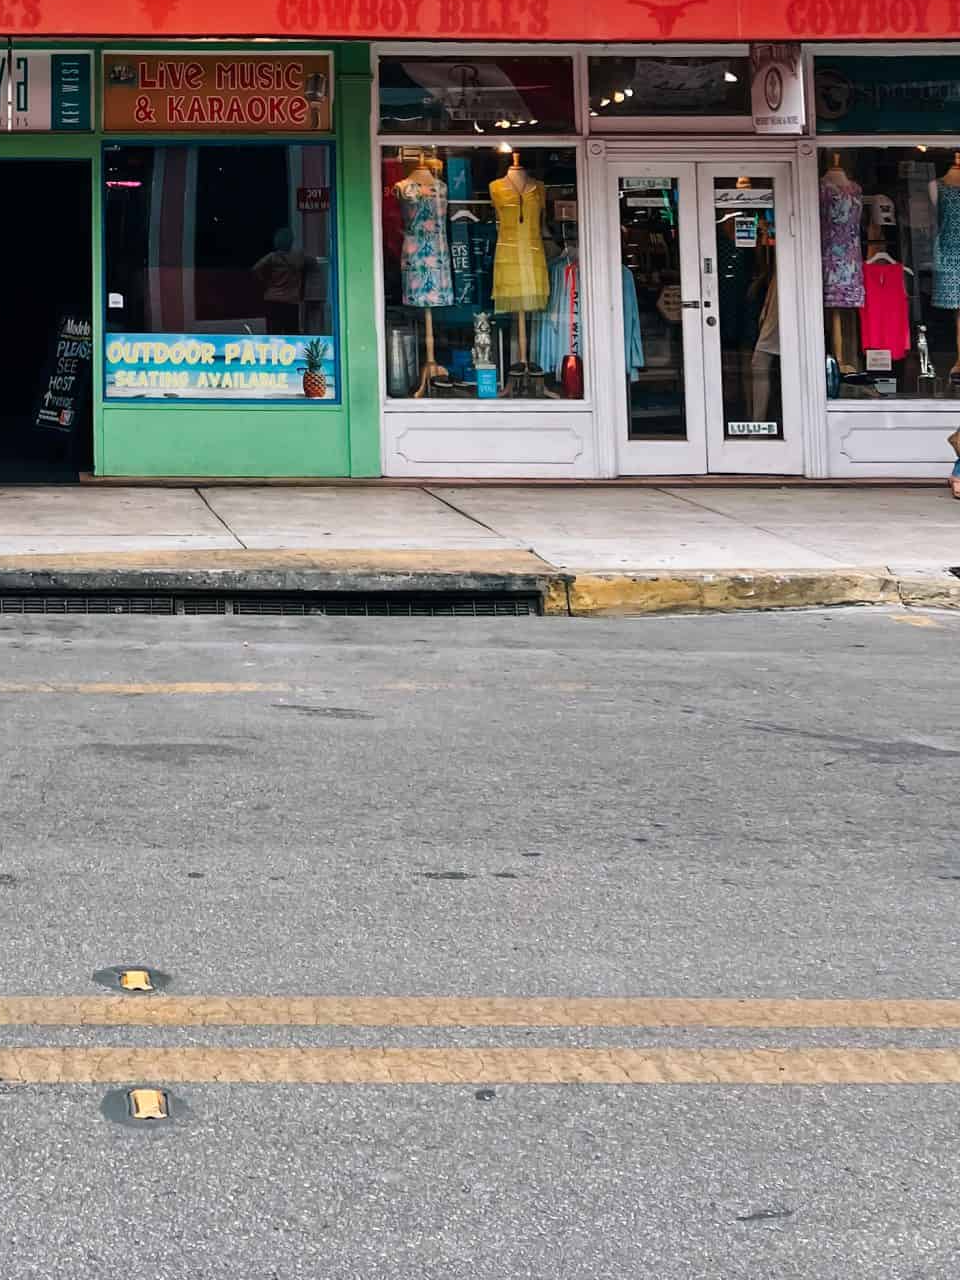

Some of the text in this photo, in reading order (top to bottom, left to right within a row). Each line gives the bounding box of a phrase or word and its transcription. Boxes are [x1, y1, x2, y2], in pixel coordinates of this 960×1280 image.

[61, 61, 80, 124] KEY WEST
[136, 95, 156, 123] &
[107, 341, 297, 366] OUTDOOR PATIO
[57, 359, 79, 375] SEE
[48, 375, 76, 392] HOST
[115, 371, 289, 389] SEATING AVAILABLE
